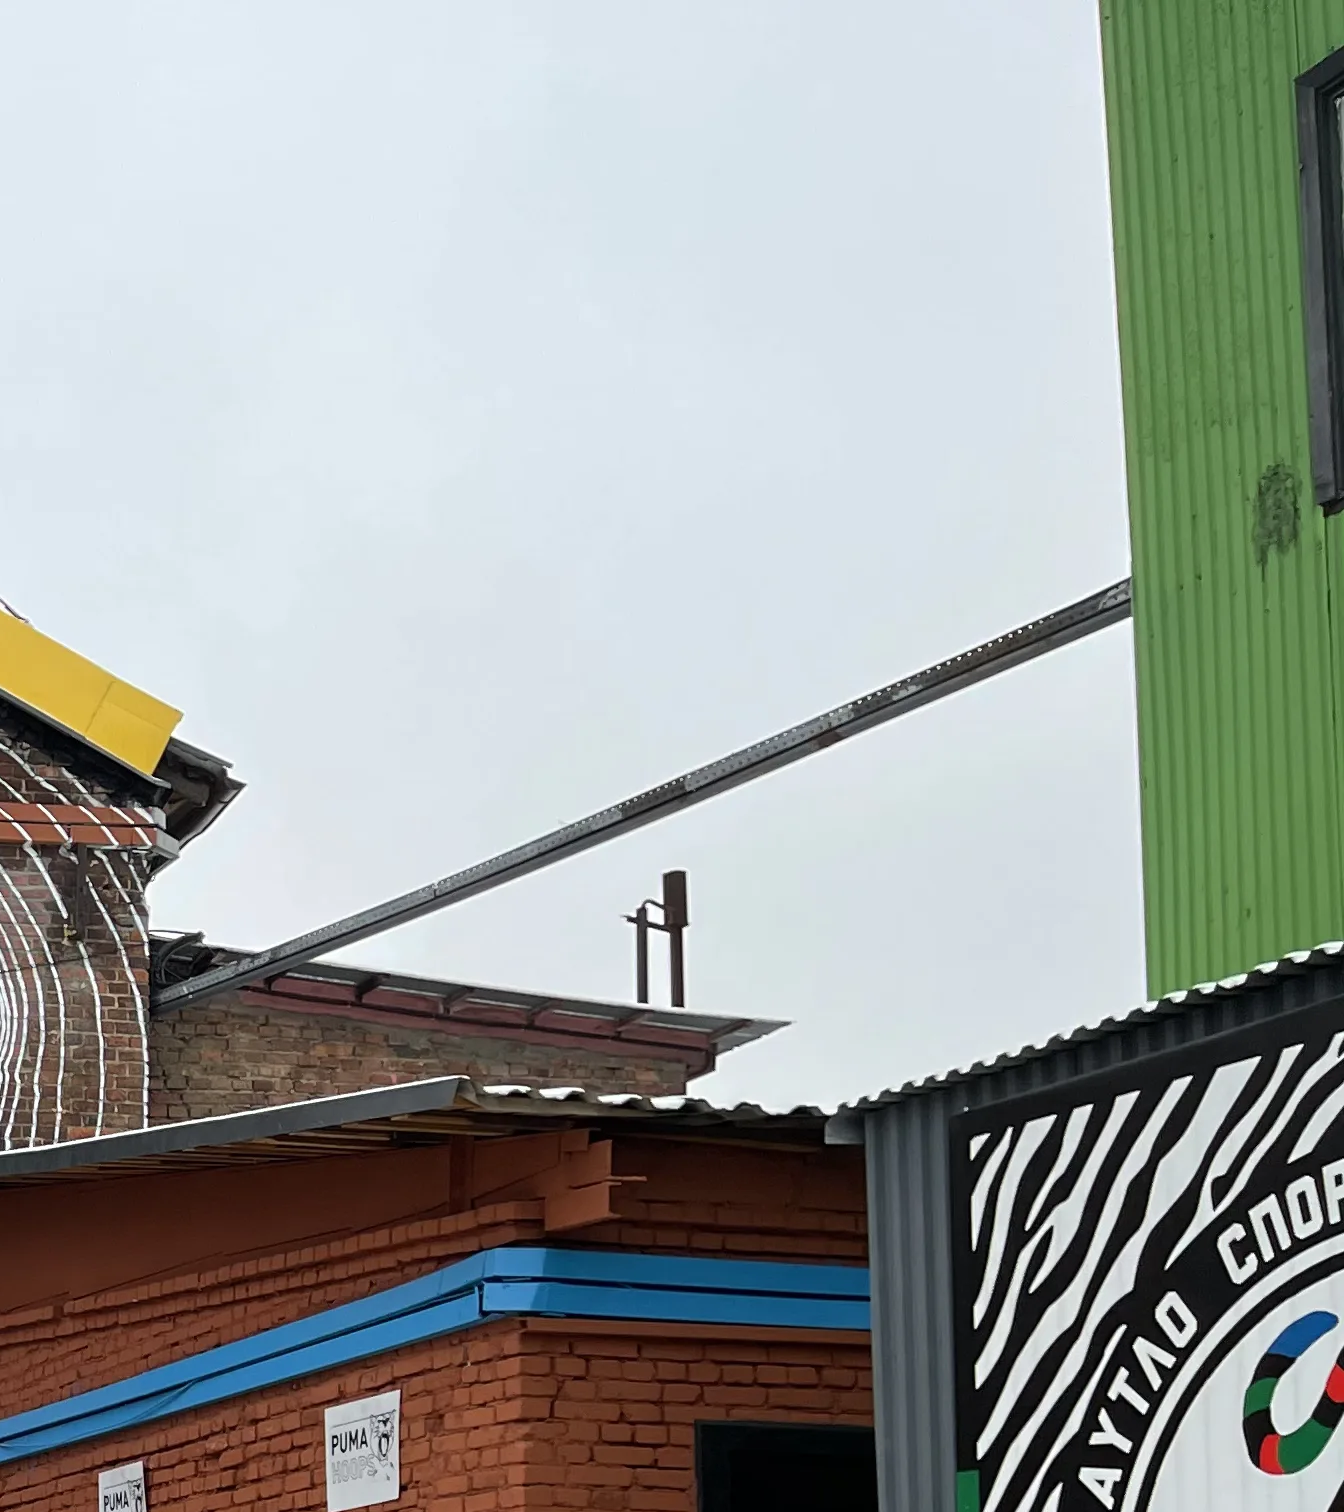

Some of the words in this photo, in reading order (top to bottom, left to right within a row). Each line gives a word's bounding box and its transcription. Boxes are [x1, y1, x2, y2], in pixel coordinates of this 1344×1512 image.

[332, 1427, 368, 1456] PUMA
[332, 1454, 378, 1484] HOOPS
[104, 1490, 130, 1512] PUMA
